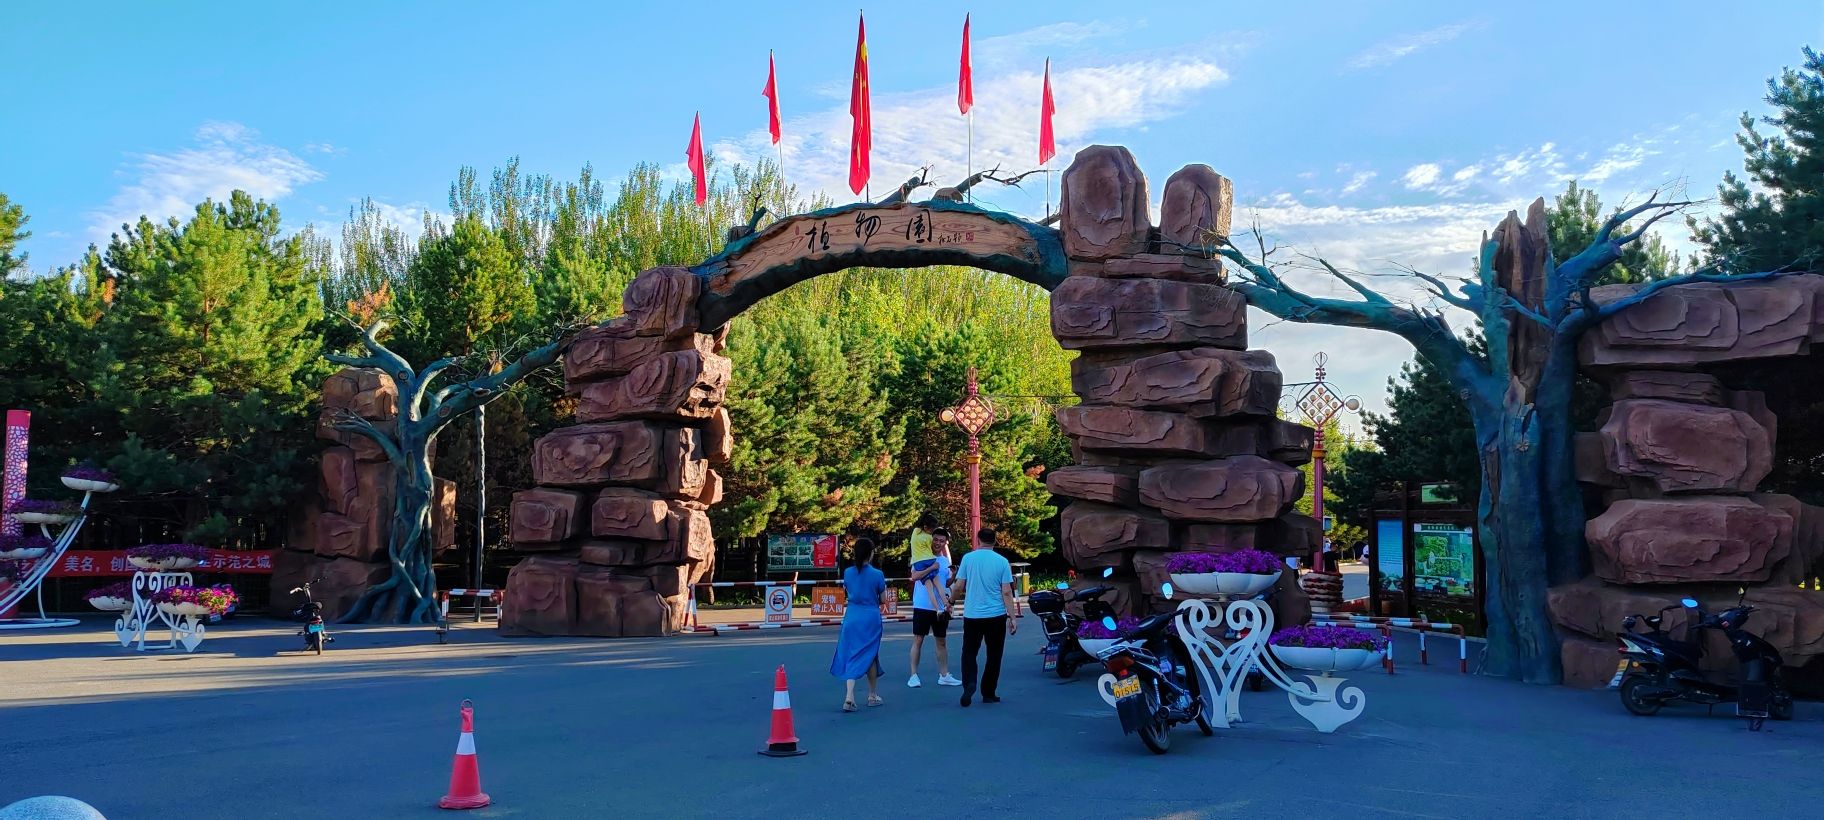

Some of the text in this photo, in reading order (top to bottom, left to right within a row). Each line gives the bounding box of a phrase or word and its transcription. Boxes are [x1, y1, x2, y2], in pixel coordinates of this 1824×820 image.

[821, 594, 836, 604] 宠物
[812, 604, 843, 614] 禁止入园
